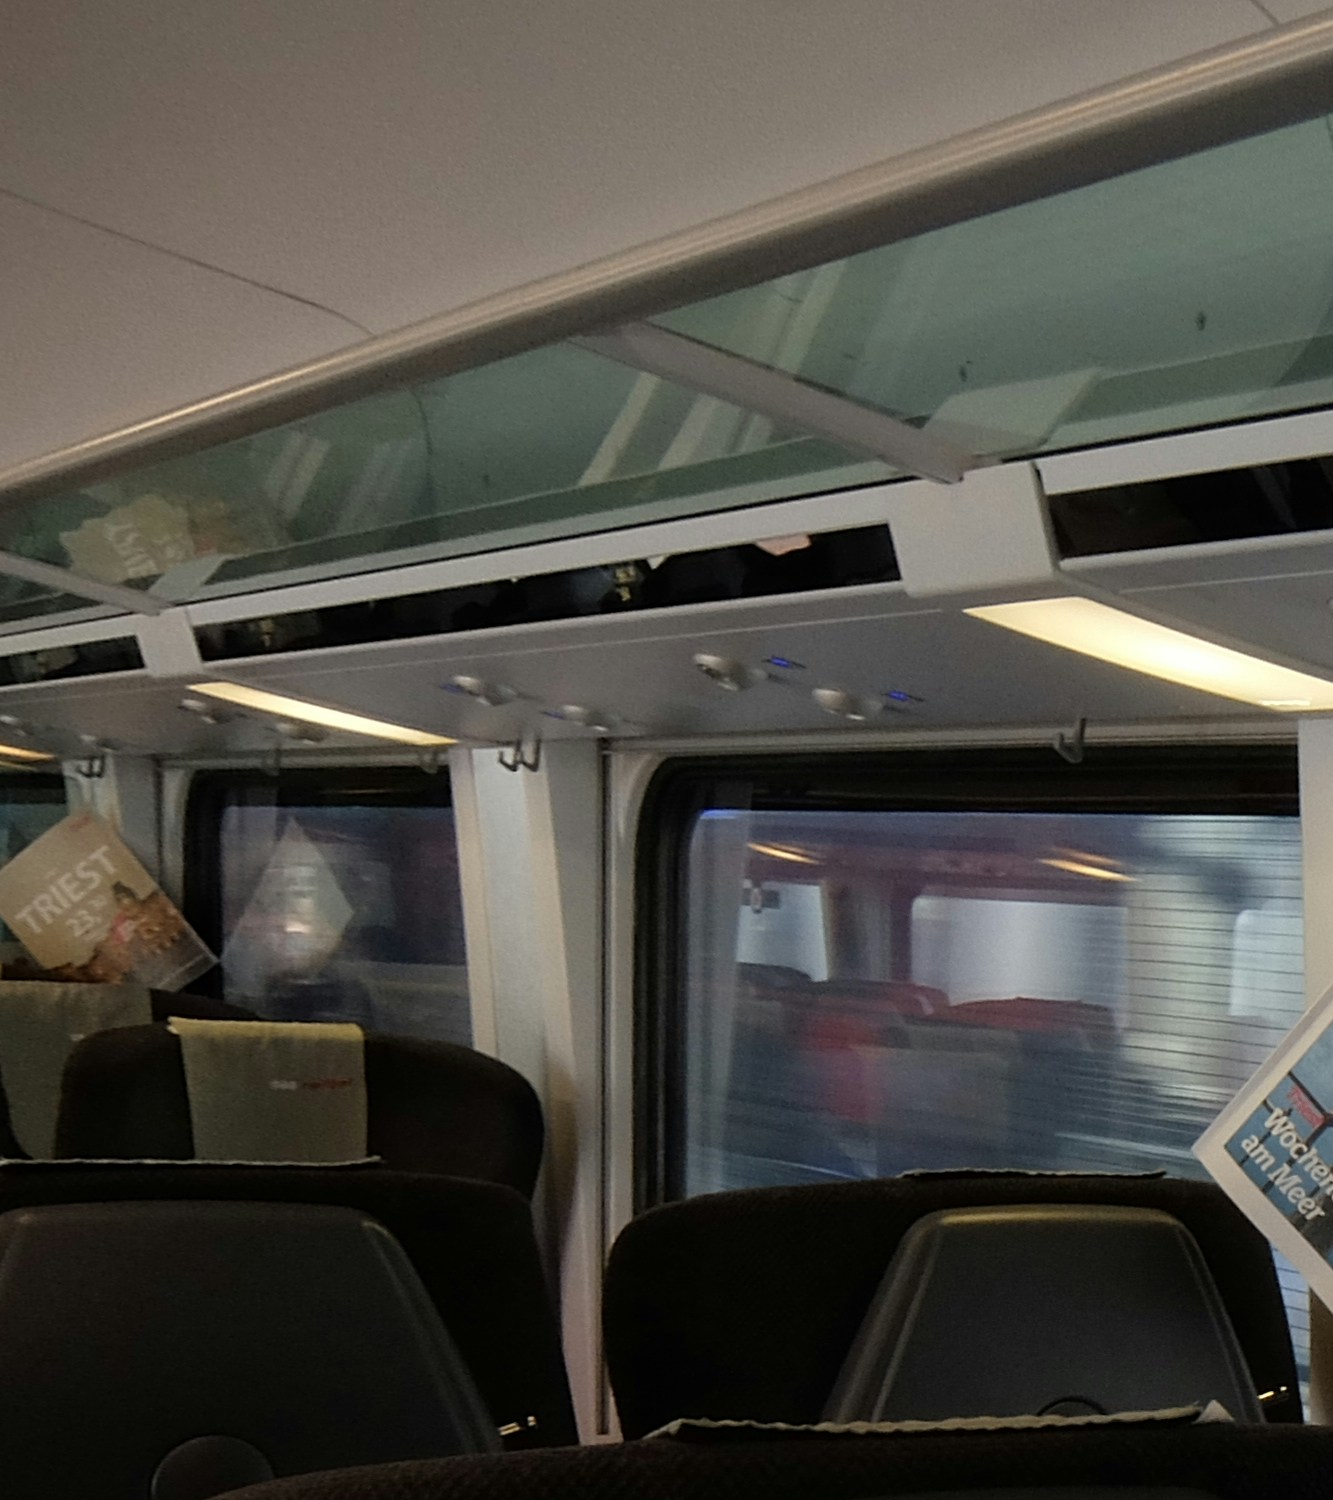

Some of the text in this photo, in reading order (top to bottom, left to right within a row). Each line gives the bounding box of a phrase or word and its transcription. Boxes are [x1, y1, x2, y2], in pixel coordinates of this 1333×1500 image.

[15, 844, 118, 934] TRIEST
[1241, 1135, 1326, 1221] am Meer
